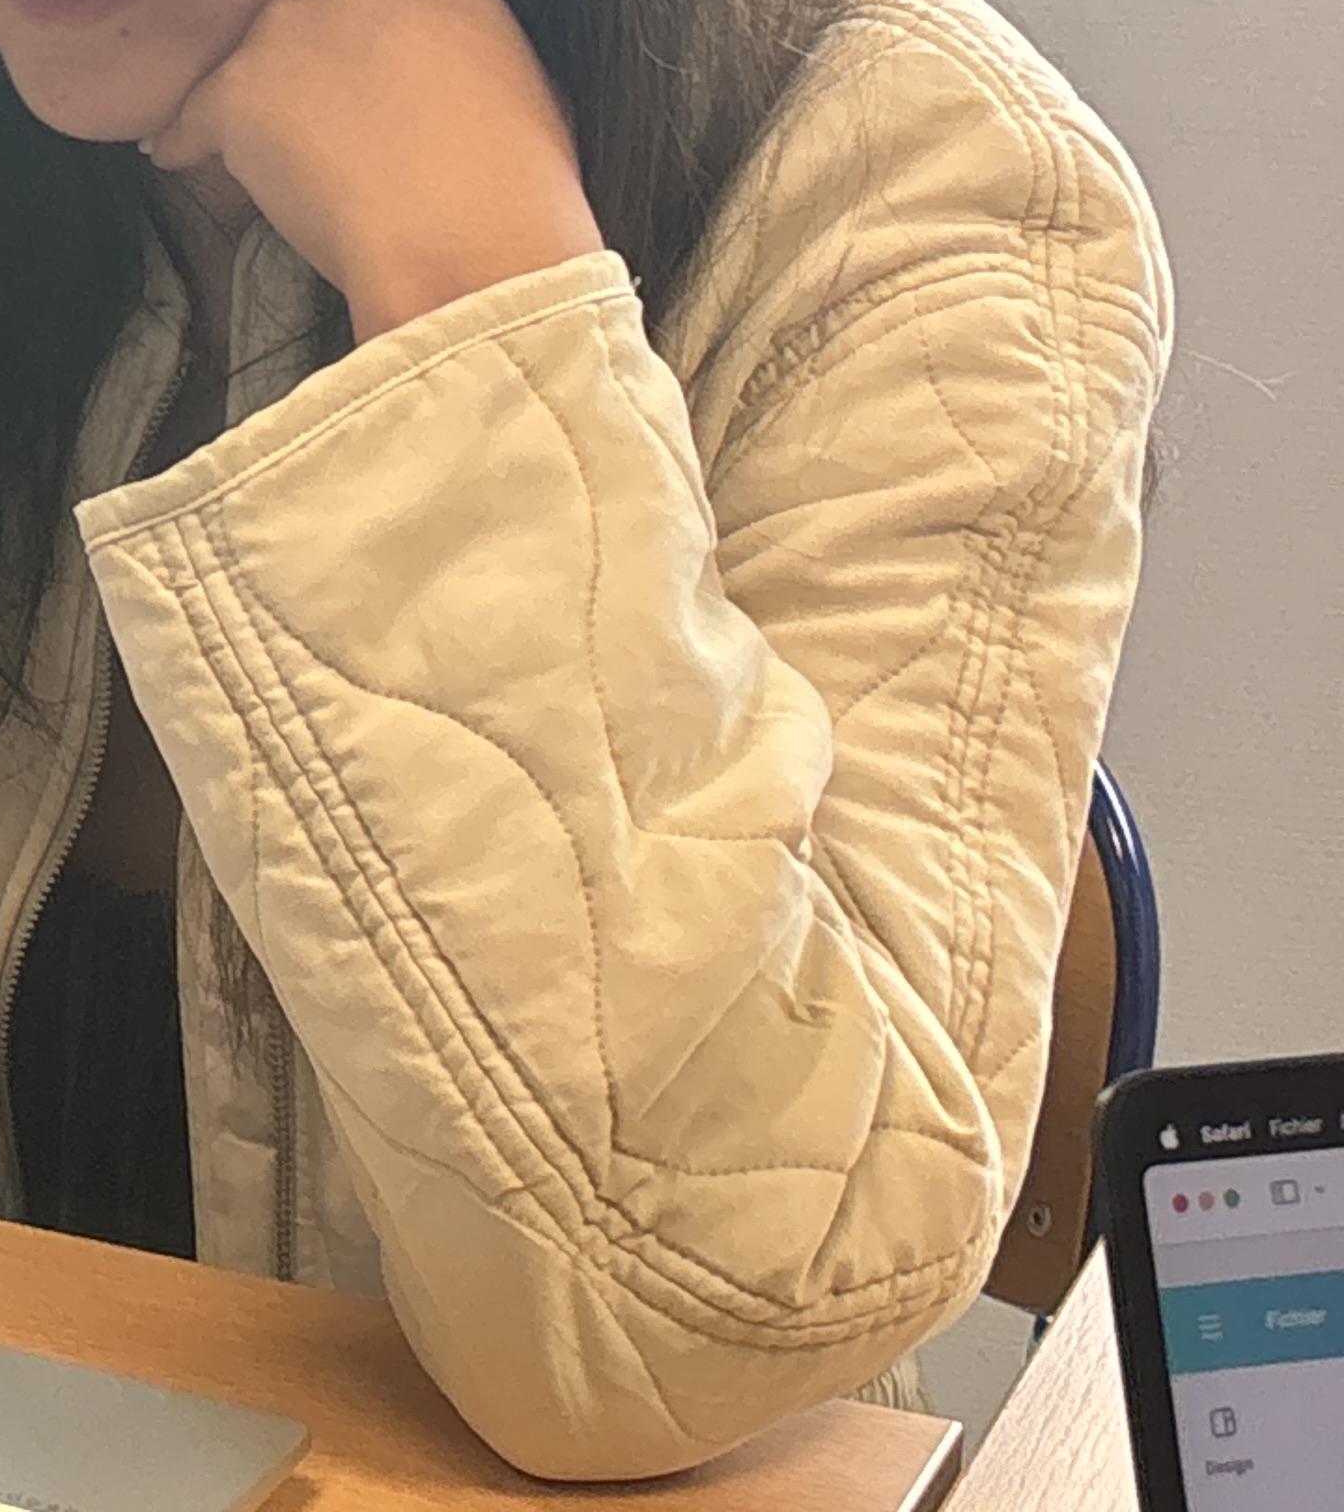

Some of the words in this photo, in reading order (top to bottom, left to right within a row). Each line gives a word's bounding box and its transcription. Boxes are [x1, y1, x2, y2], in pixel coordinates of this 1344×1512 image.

[1200, 1121, 1252, 1144] Safari
[1269, 1115, 1323, 1137] Fichier
[1265, 1305, 1327, 1331] Fichier
[1205, 1456, 1254, 1478] Design
